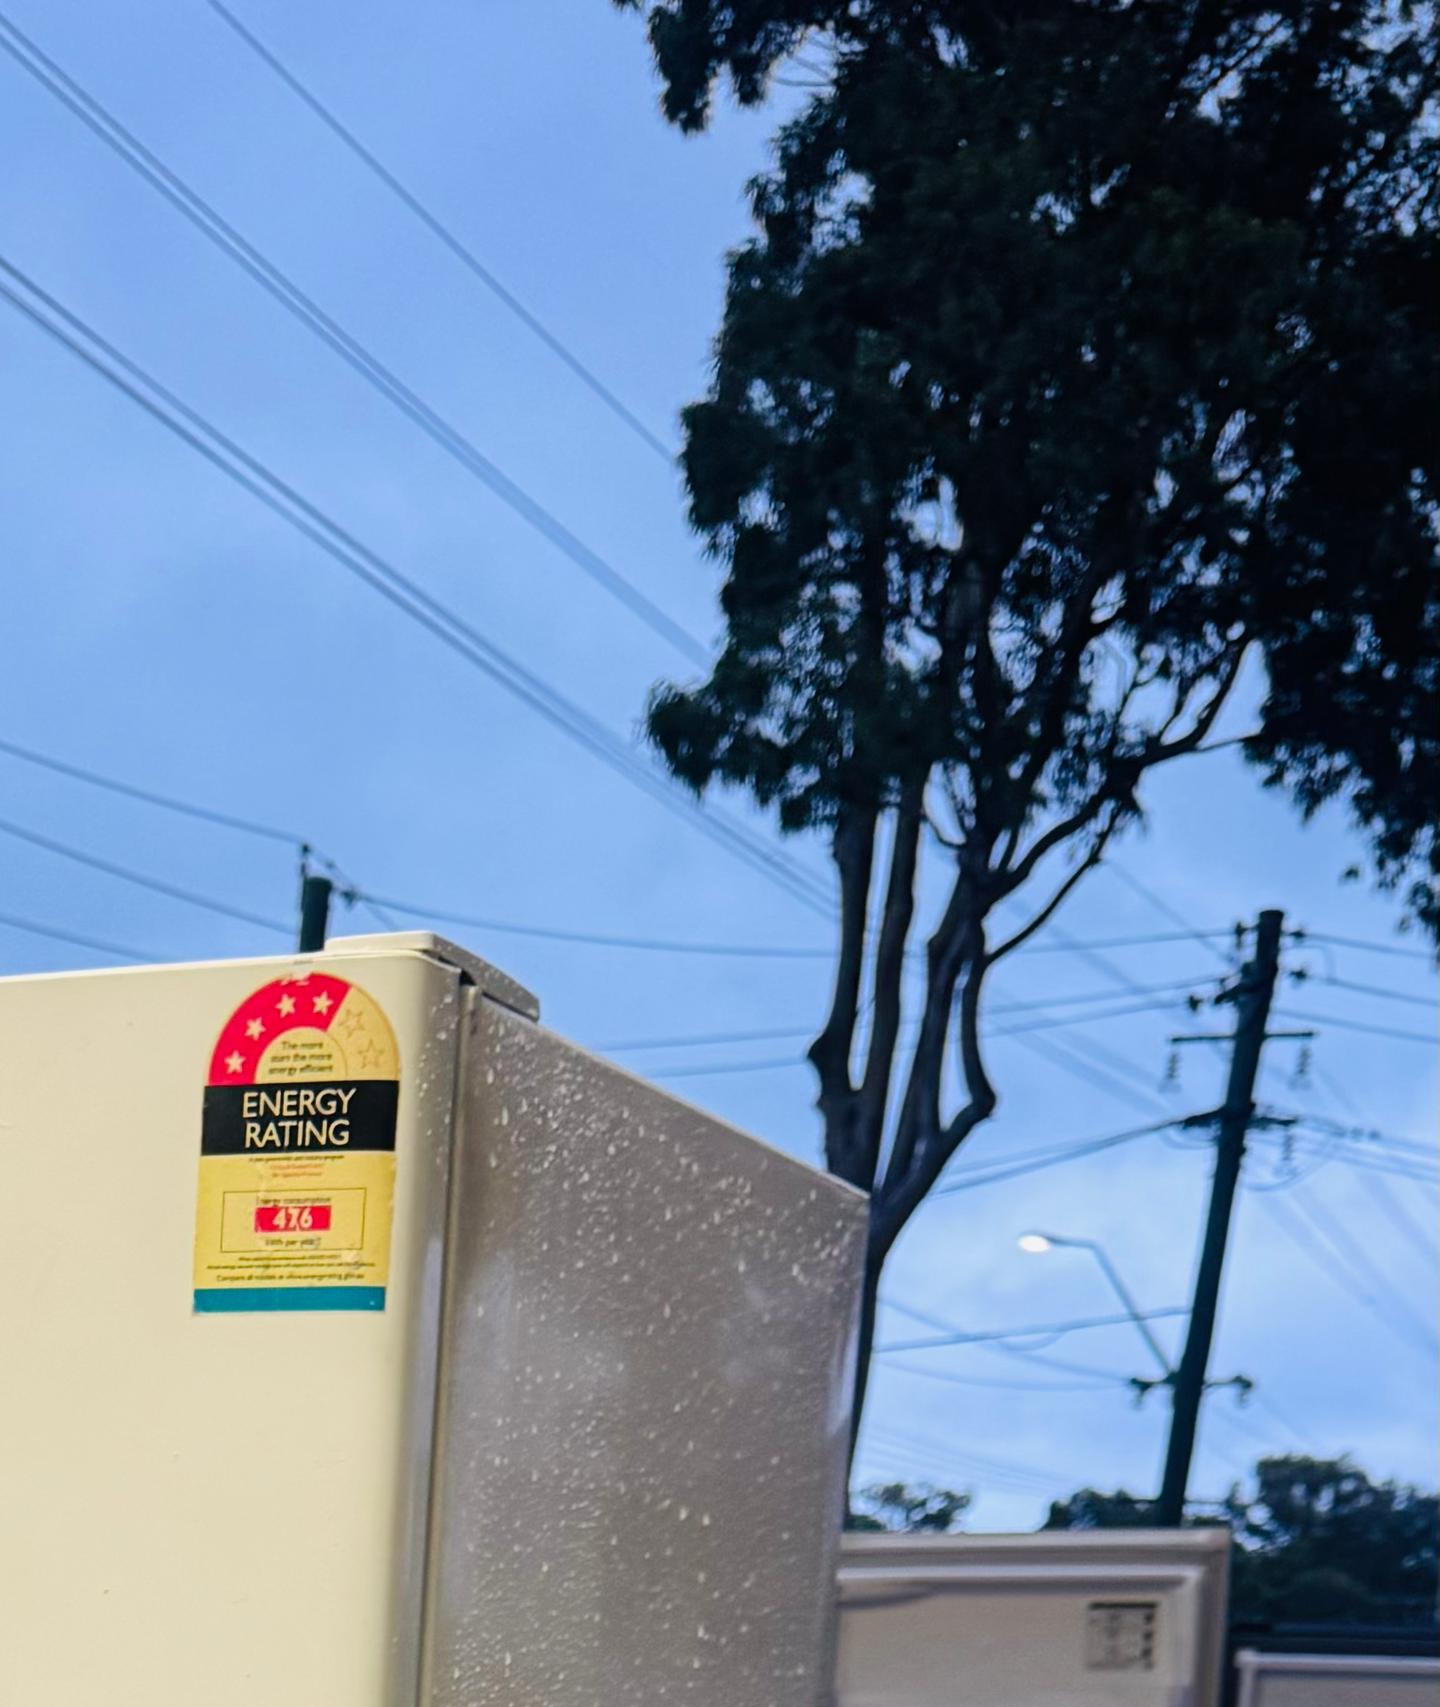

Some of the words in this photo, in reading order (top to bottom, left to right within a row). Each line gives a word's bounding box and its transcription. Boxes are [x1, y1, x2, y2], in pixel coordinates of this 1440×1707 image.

[242, 1087, 357, 1118] ENERGY
[244, 1119, 350, 1148] RATING
[272, 1206, 314, 1231] 476
